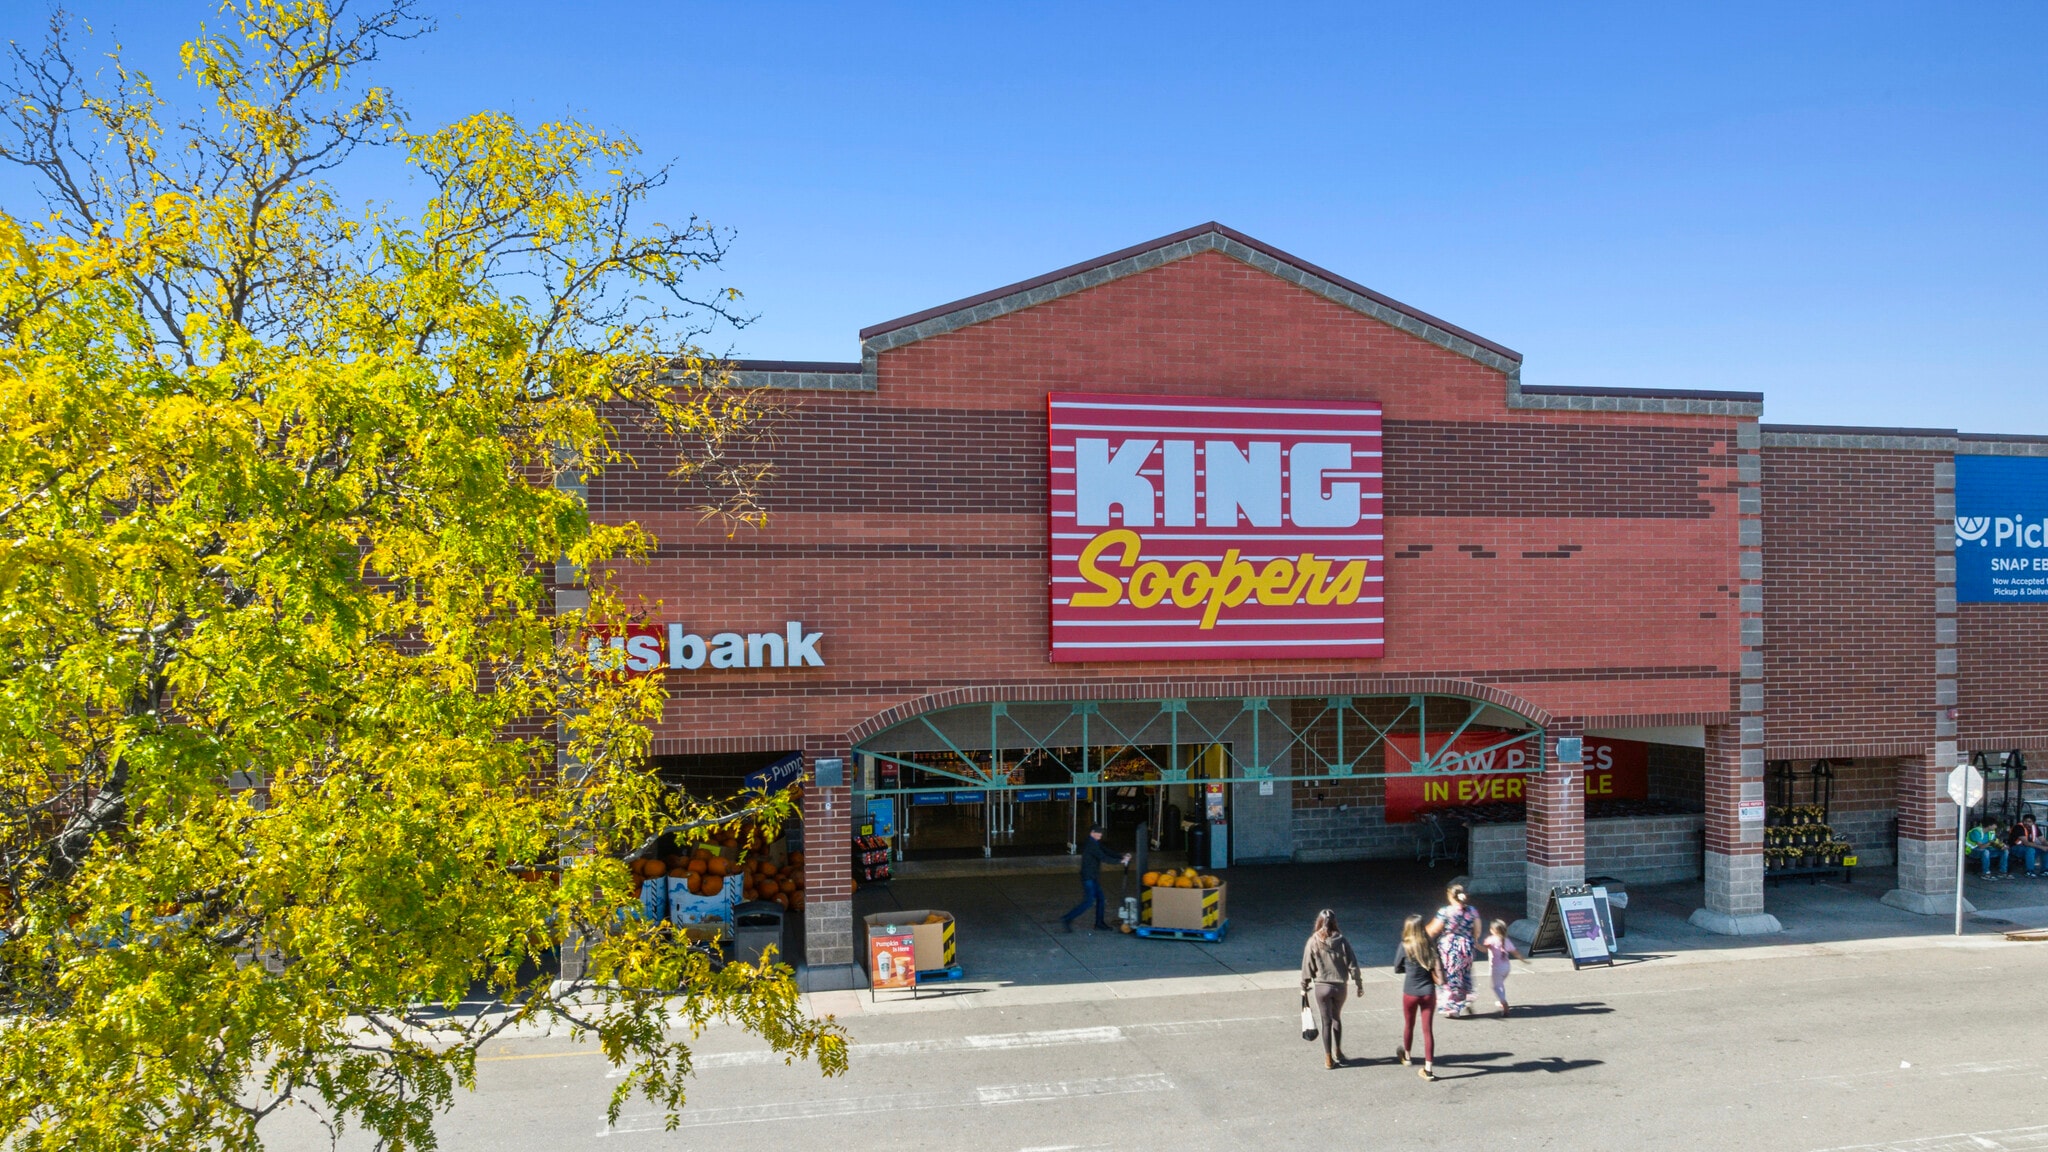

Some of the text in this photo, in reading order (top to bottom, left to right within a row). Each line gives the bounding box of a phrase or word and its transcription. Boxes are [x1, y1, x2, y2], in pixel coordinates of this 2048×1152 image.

[1076, 438, 1360, 528] KING
[1991, 558, 2029, 571] SNAP
[1069, 529, 1368, 630] Soopers
[1992, 577, 2045, 586] Now Accepted
[1993, 587, 2018, 597] Pickup
[771, 756, 804, 781] Pump
[1424, 778, 1528, 802] IN EVER
